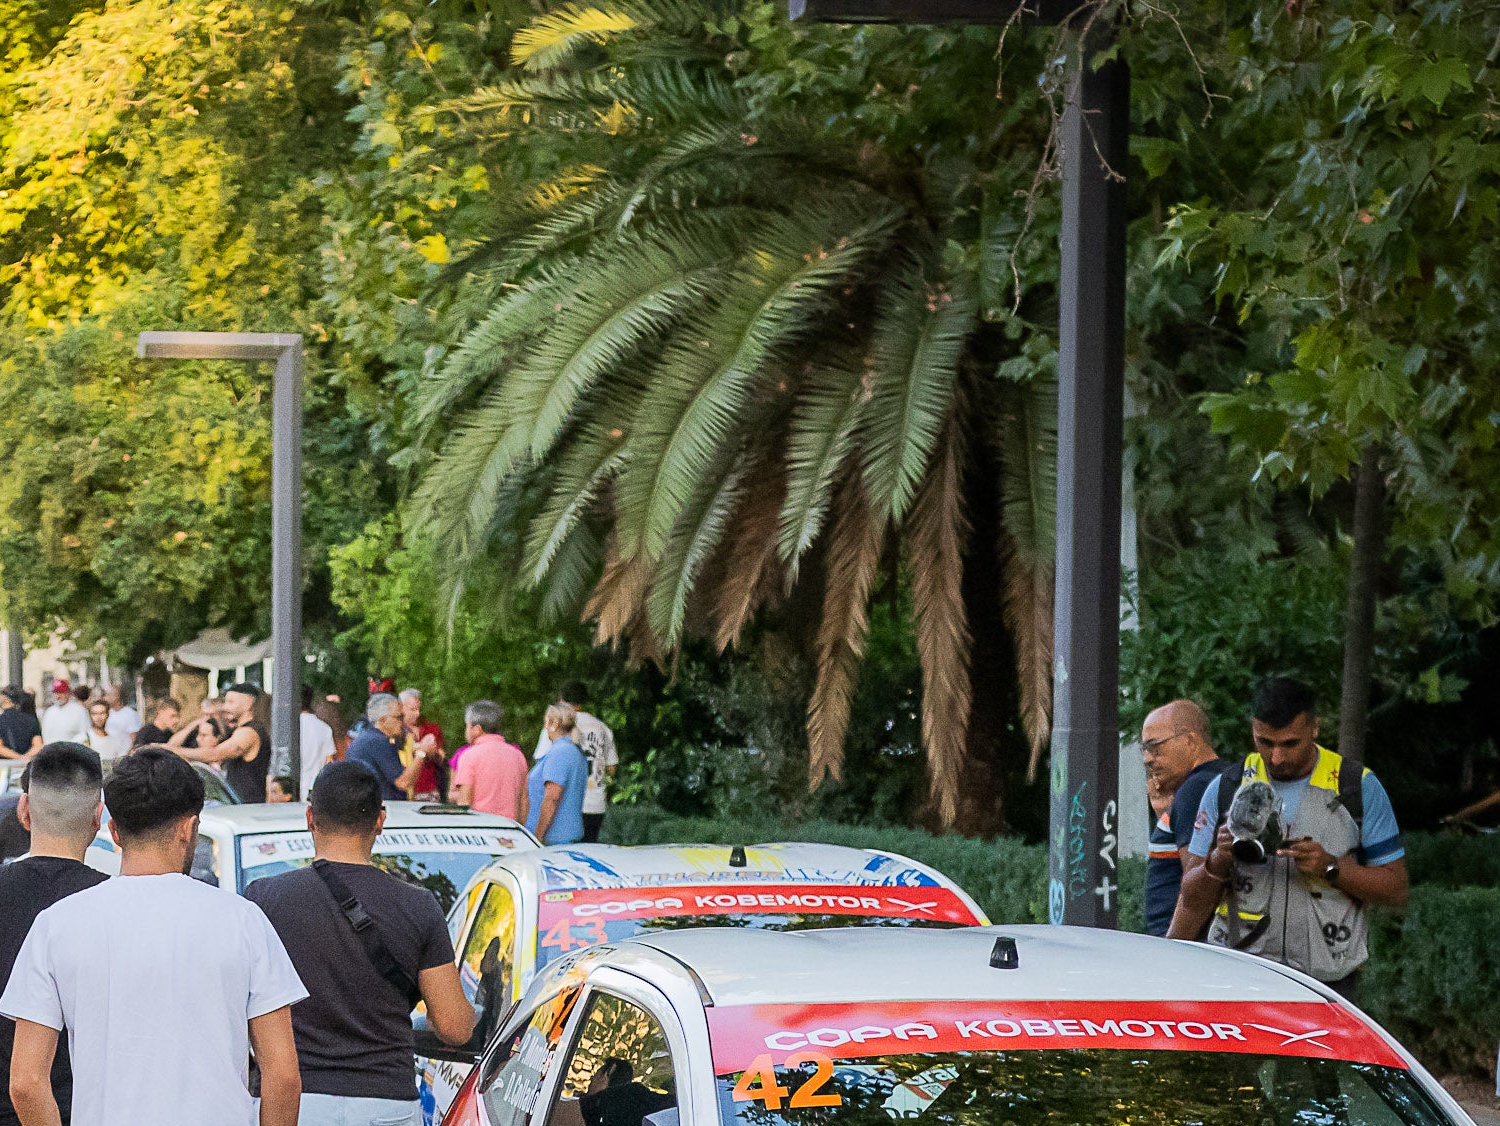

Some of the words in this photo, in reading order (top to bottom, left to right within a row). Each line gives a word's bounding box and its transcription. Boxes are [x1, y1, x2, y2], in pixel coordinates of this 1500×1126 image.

[432, 833, 490, 848] GRANADA
[571, 897, 684, 918] COPA
[695, 894, 881, 911] KOBEMOTOR
[541, 916, 609, 952] 43
[764, 1021, 938, 1050] COPA
[955, 1019, 1247, 1041] KOBEMOTOR
[732, 1051, 843, 1111] 42
